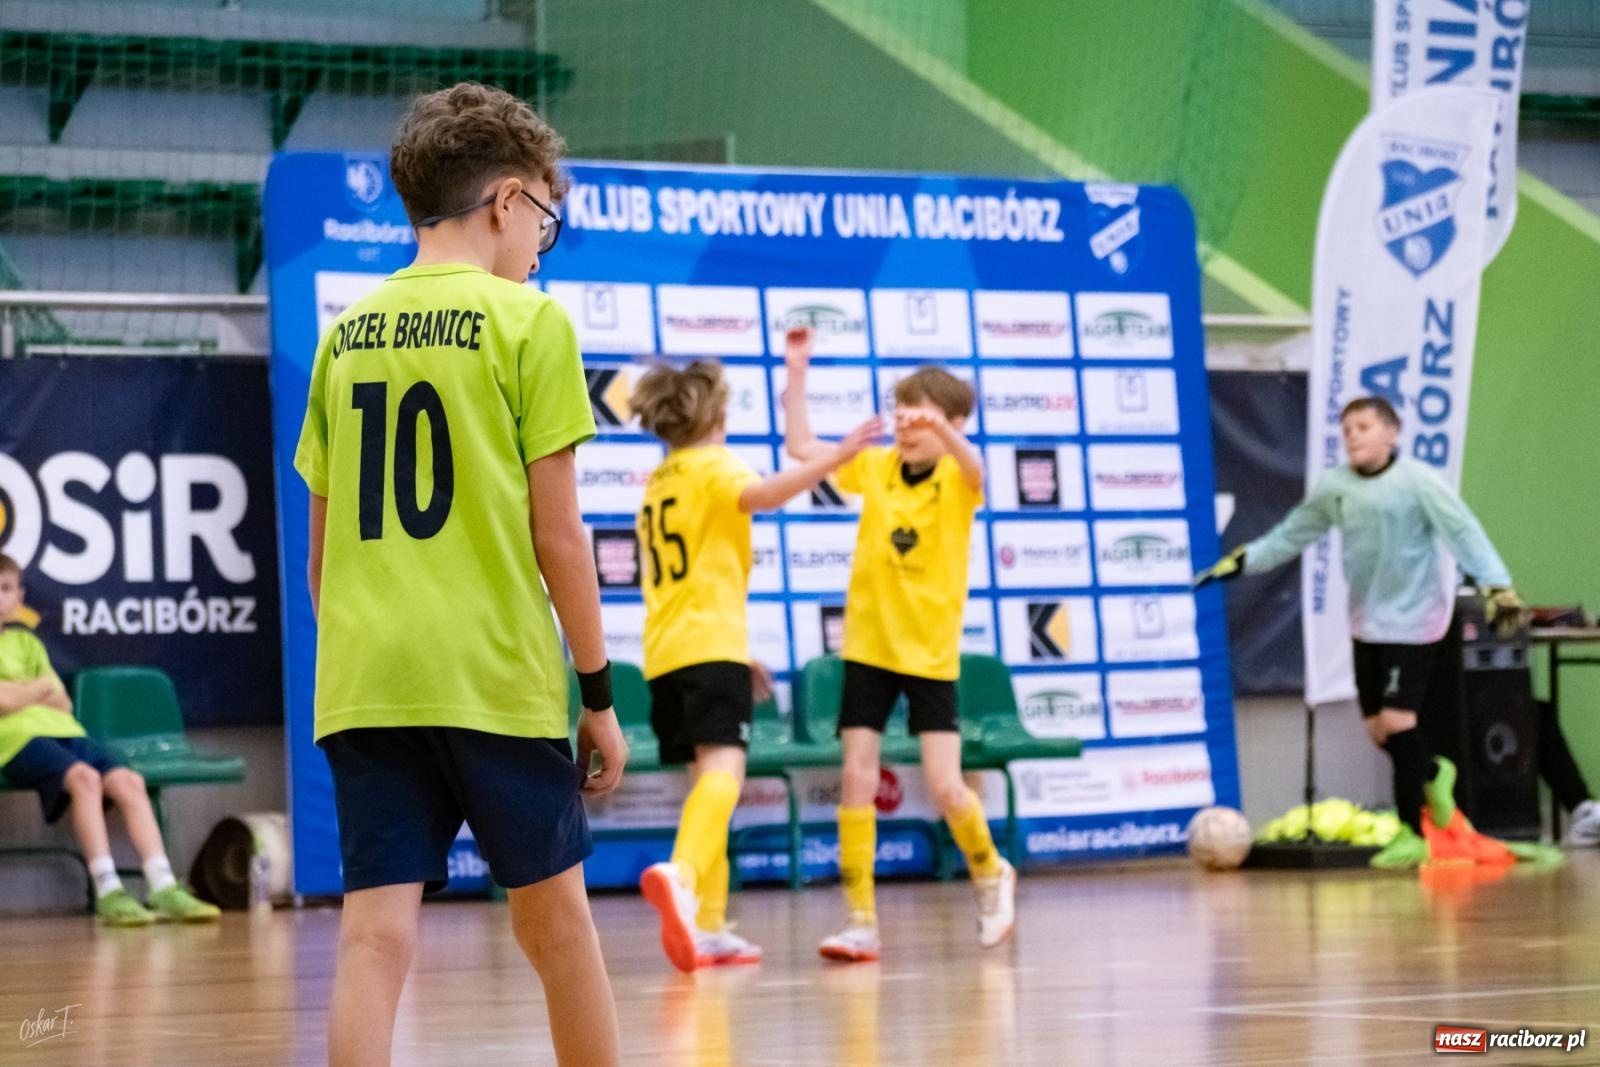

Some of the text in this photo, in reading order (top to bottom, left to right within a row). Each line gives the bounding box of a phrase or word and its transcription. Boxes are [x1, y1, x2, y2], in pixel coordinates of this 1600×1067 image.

[567, 183, 653, 232] KLUB
[657, 186, 827, 237] SPORTOWY
[833, 193, 911, 239] UNIA
[913, 187, 1064, 242] RACIBÓRZ
[393, 309, 486, 350] BRANICE
[1327, 287, 1351, 424] SPORTOWY
[1409, 297, 1455, 468] BÓRZ
[352, 381, 454, 541] 10
[62, 586, 257, 635] RACIBÓRZ
[1027, 820, 1190, 854] uniaraciborz.
